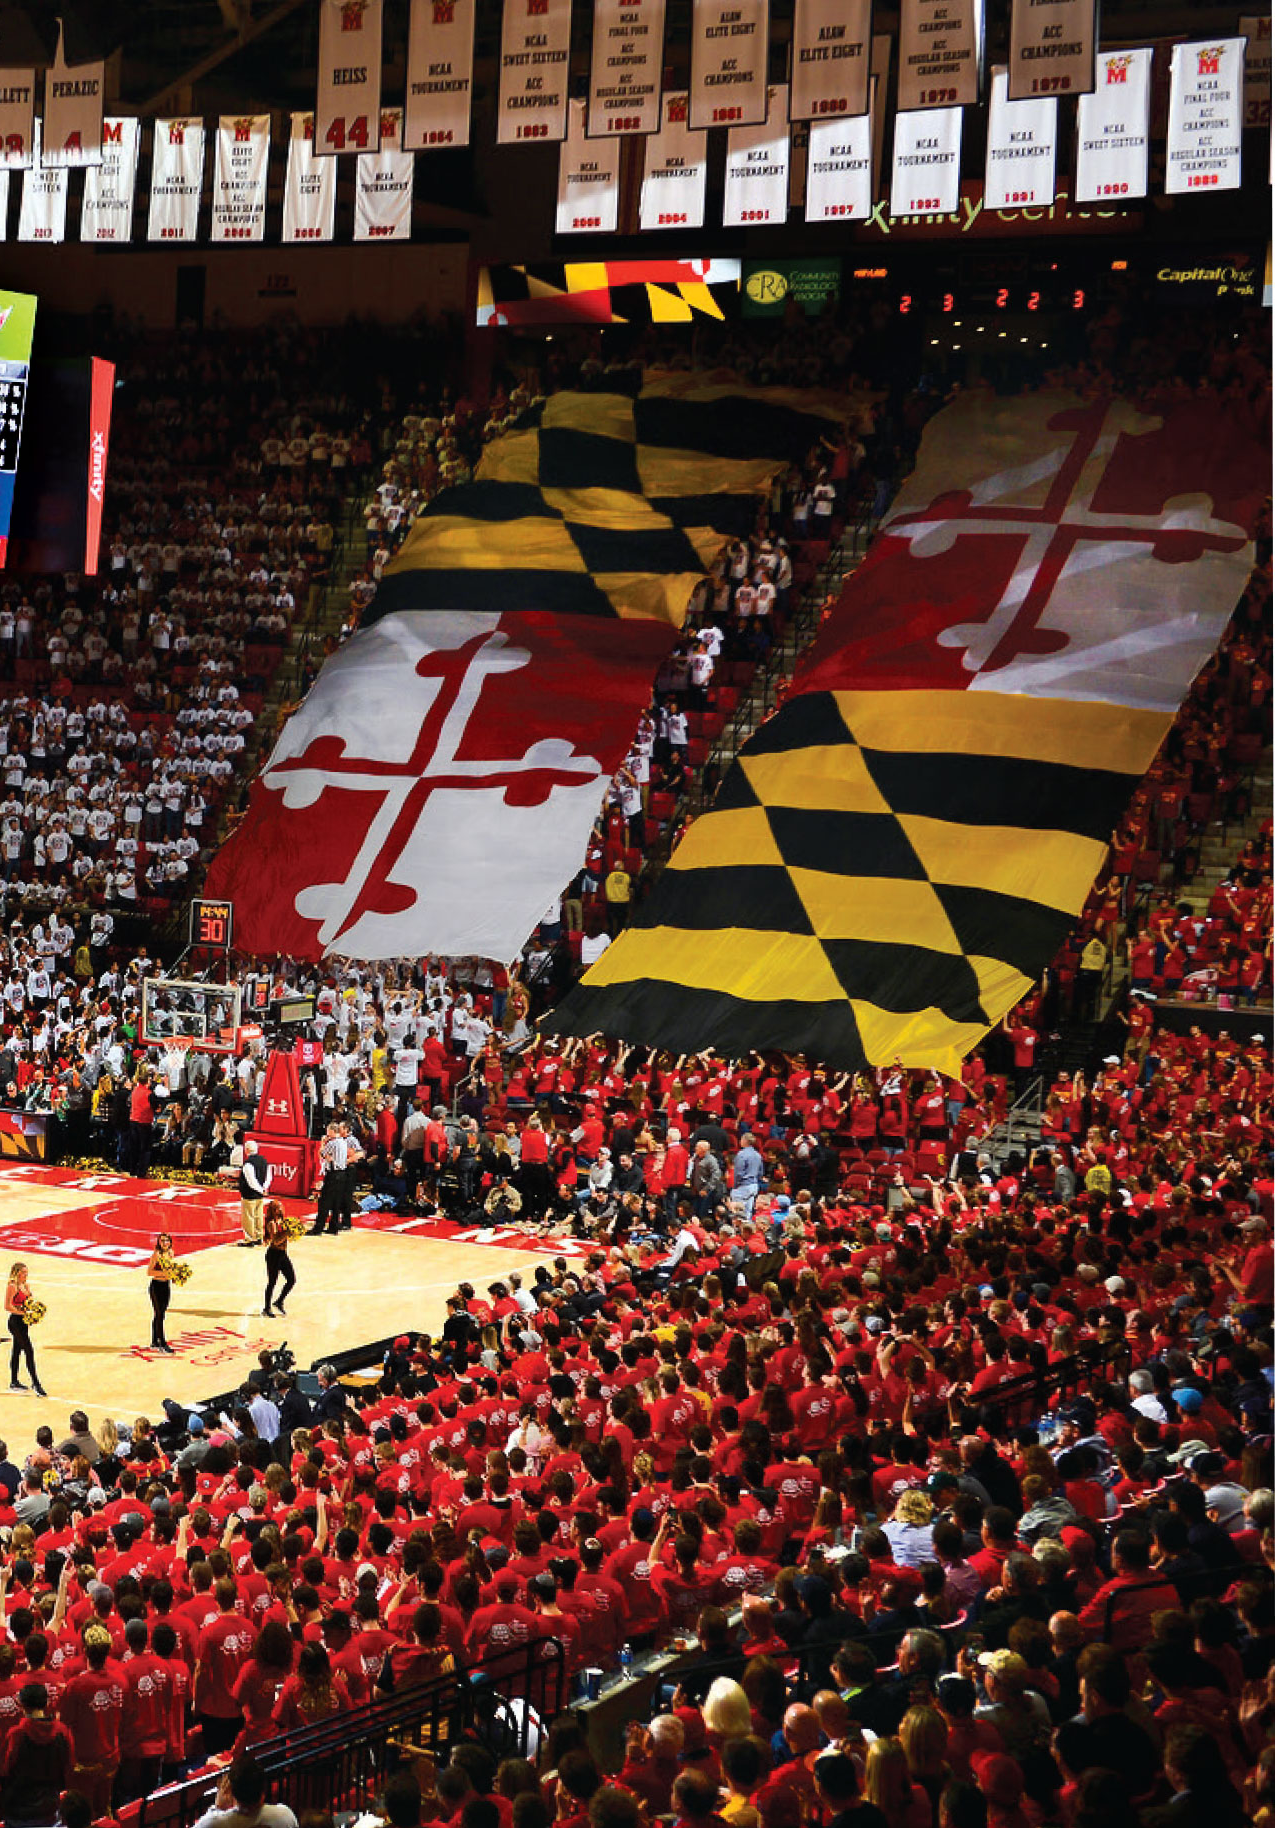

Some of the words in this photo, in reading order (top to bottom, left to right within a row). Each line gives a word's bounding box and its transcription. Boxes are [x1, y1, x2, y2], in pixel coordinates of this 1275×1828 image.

[620, 13, 639, 24] NCAA
[934, 9, 948, 19] ACC
[609, 26, 629, 37] FINAL
[631, 24, 649, 36] FOUR
[705, 24, 729, 39] ELITE
[731, 22, 756, 36] EIGHT
[918, 19, 962, 33] CHAMPIONS
[1042, 25, 1062, 40] ACC
[525, 34, 548, 47] NCAA
[932, 40, 947, 50] ACC
[621, 43, 635, 54] ACC
[800, 46, 830, 63] ELITE
[831, 43, 863, 59] EIGHT
[1021, 42, 1083, 60] CHAMPIONS
[503, 53, 530, 67] SWEET
[532, 51, 567, 65] SIXTEEN
[607, 55, 647, 67] CHAMPIONS
[908, 53, 940, 65] REGULAR
[943, 50, 971, 62] SEASON
[429, 63, 452, 76] NCAA
[722, 59, 738, 71] ACC
[917, 63, 960, 76] CHAMPIONS
[333, 68, 367, 86] HEISS
[525, 77, 543, 90] ACC
[619, 74, 634, 84] ACC
[704, 71, 754, 86] CHAMPIONS
[52, 80, 99, 98] PERAZIC
[411, 80, 469, 95] TOURNAMENT
[596, 87, 627, 98] REGULAR
[629, 85, 654, 95] SEASON
[1196, 81, 1218, 91] NCAA
[506, 94, 559, 109] CHAMPIONS
[604, 97, 644, 109] CHAMPIONS
[1184, 93, 1207, 104] FINAL
[1209, 91, 1230, 102] FOUR
[1199, 108, 1214, 118] ACC
[1104, 124, 1125, 134] NCAA
[1183, 119, 1229, 132] CHAMPIONS
[326, 116, 369, 149] 44
[1010, 132, 1034, 143] NCAA
[63, 131, 82, 158] 4
[916, 138, 939, 149] NCAA
[1083, 139, 1109, 151] SWEET
[1111, 137, 1145, 148] SIXTEEN
[1198, 137, 1213, 146] ACC
[747, 151, 768, 162] NCAA
[829, 145, 852, 156] NCAA
[991, 146, 1051, 160] TOURNAMENT
[1171, 149, 1206, 160] REGULAR
[1208, 146, 1240, 157] SEASON
[666, 157, 685, 167] NCAA
[898, 152, 955, 167] TOURNAMENT
[1181, 159, 1227, 171] CHAMPIONS
[580, 162, 598, 172] NCAA
[730, 165, 785, 178] TOURNAMENT
[813, 160, 869, 173] TOURNAMENT
[567, 173, 611, 183] TOURNAMENT
[651, 168, 698, 179] TOURNAMENT
[152, 185, 198, 195] TOURNAMENT
[361, 182, 409, 193] TOURNAMENT
[96, 228, 116, 238] 2012
[1157, 267, 1222, 283] Capital
[899, 295, 912, 314] 2
[942, 293, 954, 312] 3
[996, 288, 1008, 308] 2
[1027, 291, 1040, 311] 2
[1073, 289, 1085, 310] 3
[90, 431, 105, 501] xfinity
[200, 907, 228, 918] 14:44
[200, 918, 224, 942] 30
[268, 1160, 297, 1181] nity
